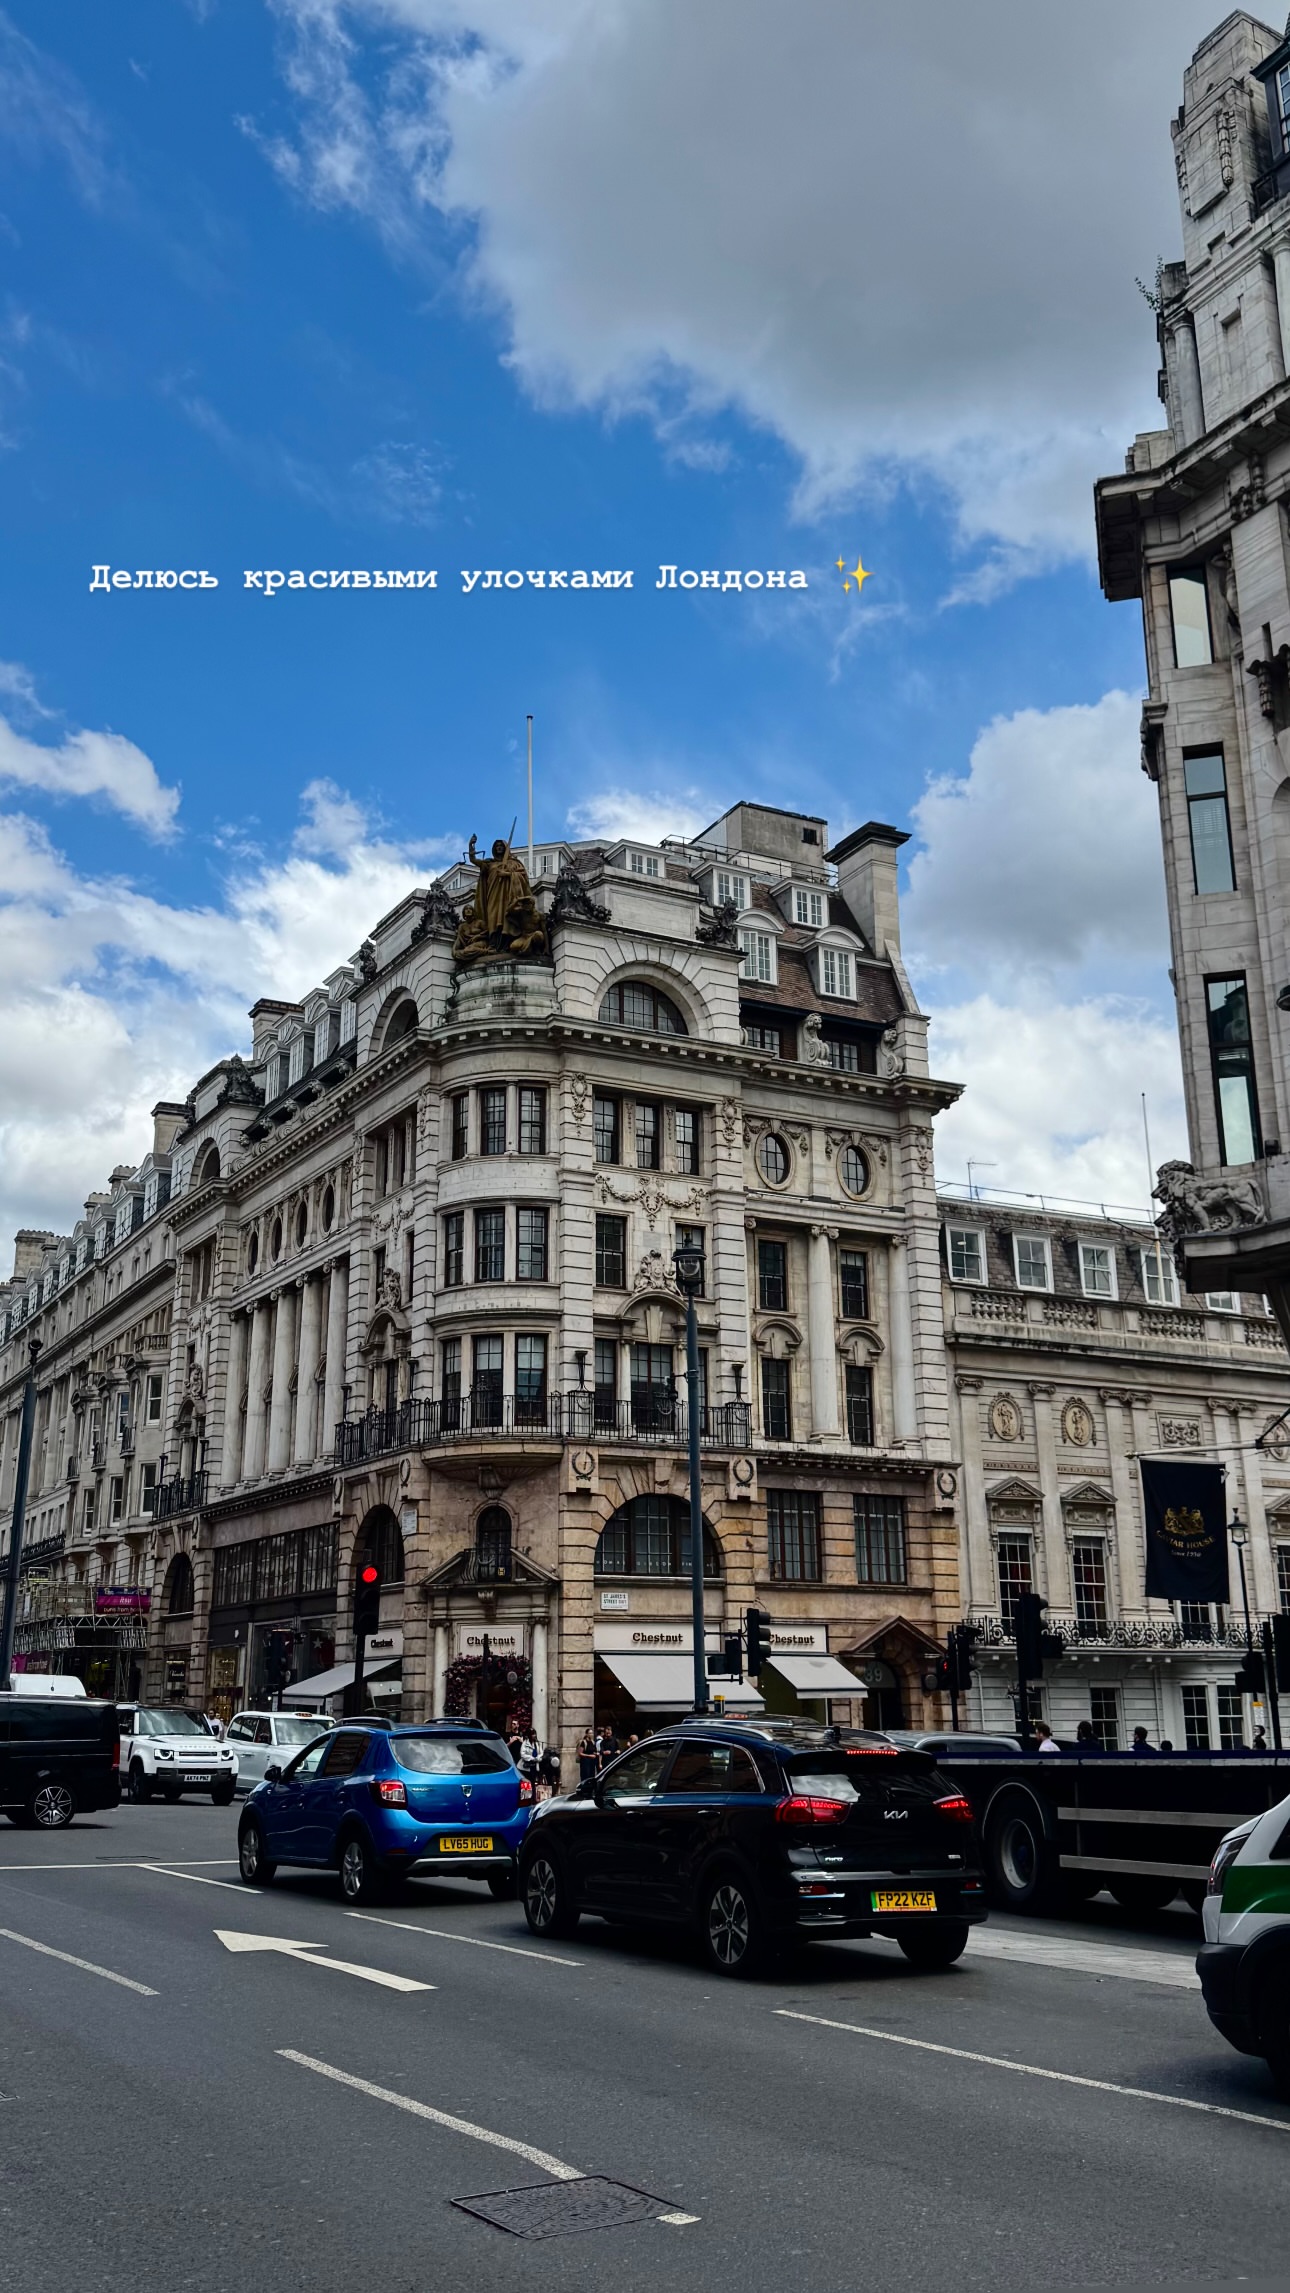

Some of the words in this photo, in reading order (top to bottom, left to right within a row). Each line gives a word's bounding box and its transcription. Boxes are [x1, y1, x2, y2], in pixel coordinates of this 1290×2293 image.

[1185, 1535, 1216, 1549] HOUSE
[632, 1632, 684, 1642] Chestnut
[768, 1634, 815, 1644] Chestnut
[470, 1838, 489, 1849] HUG
[879, 1892, 909, 1906] FP22
[911, 1892, 933, 1906] KZF
